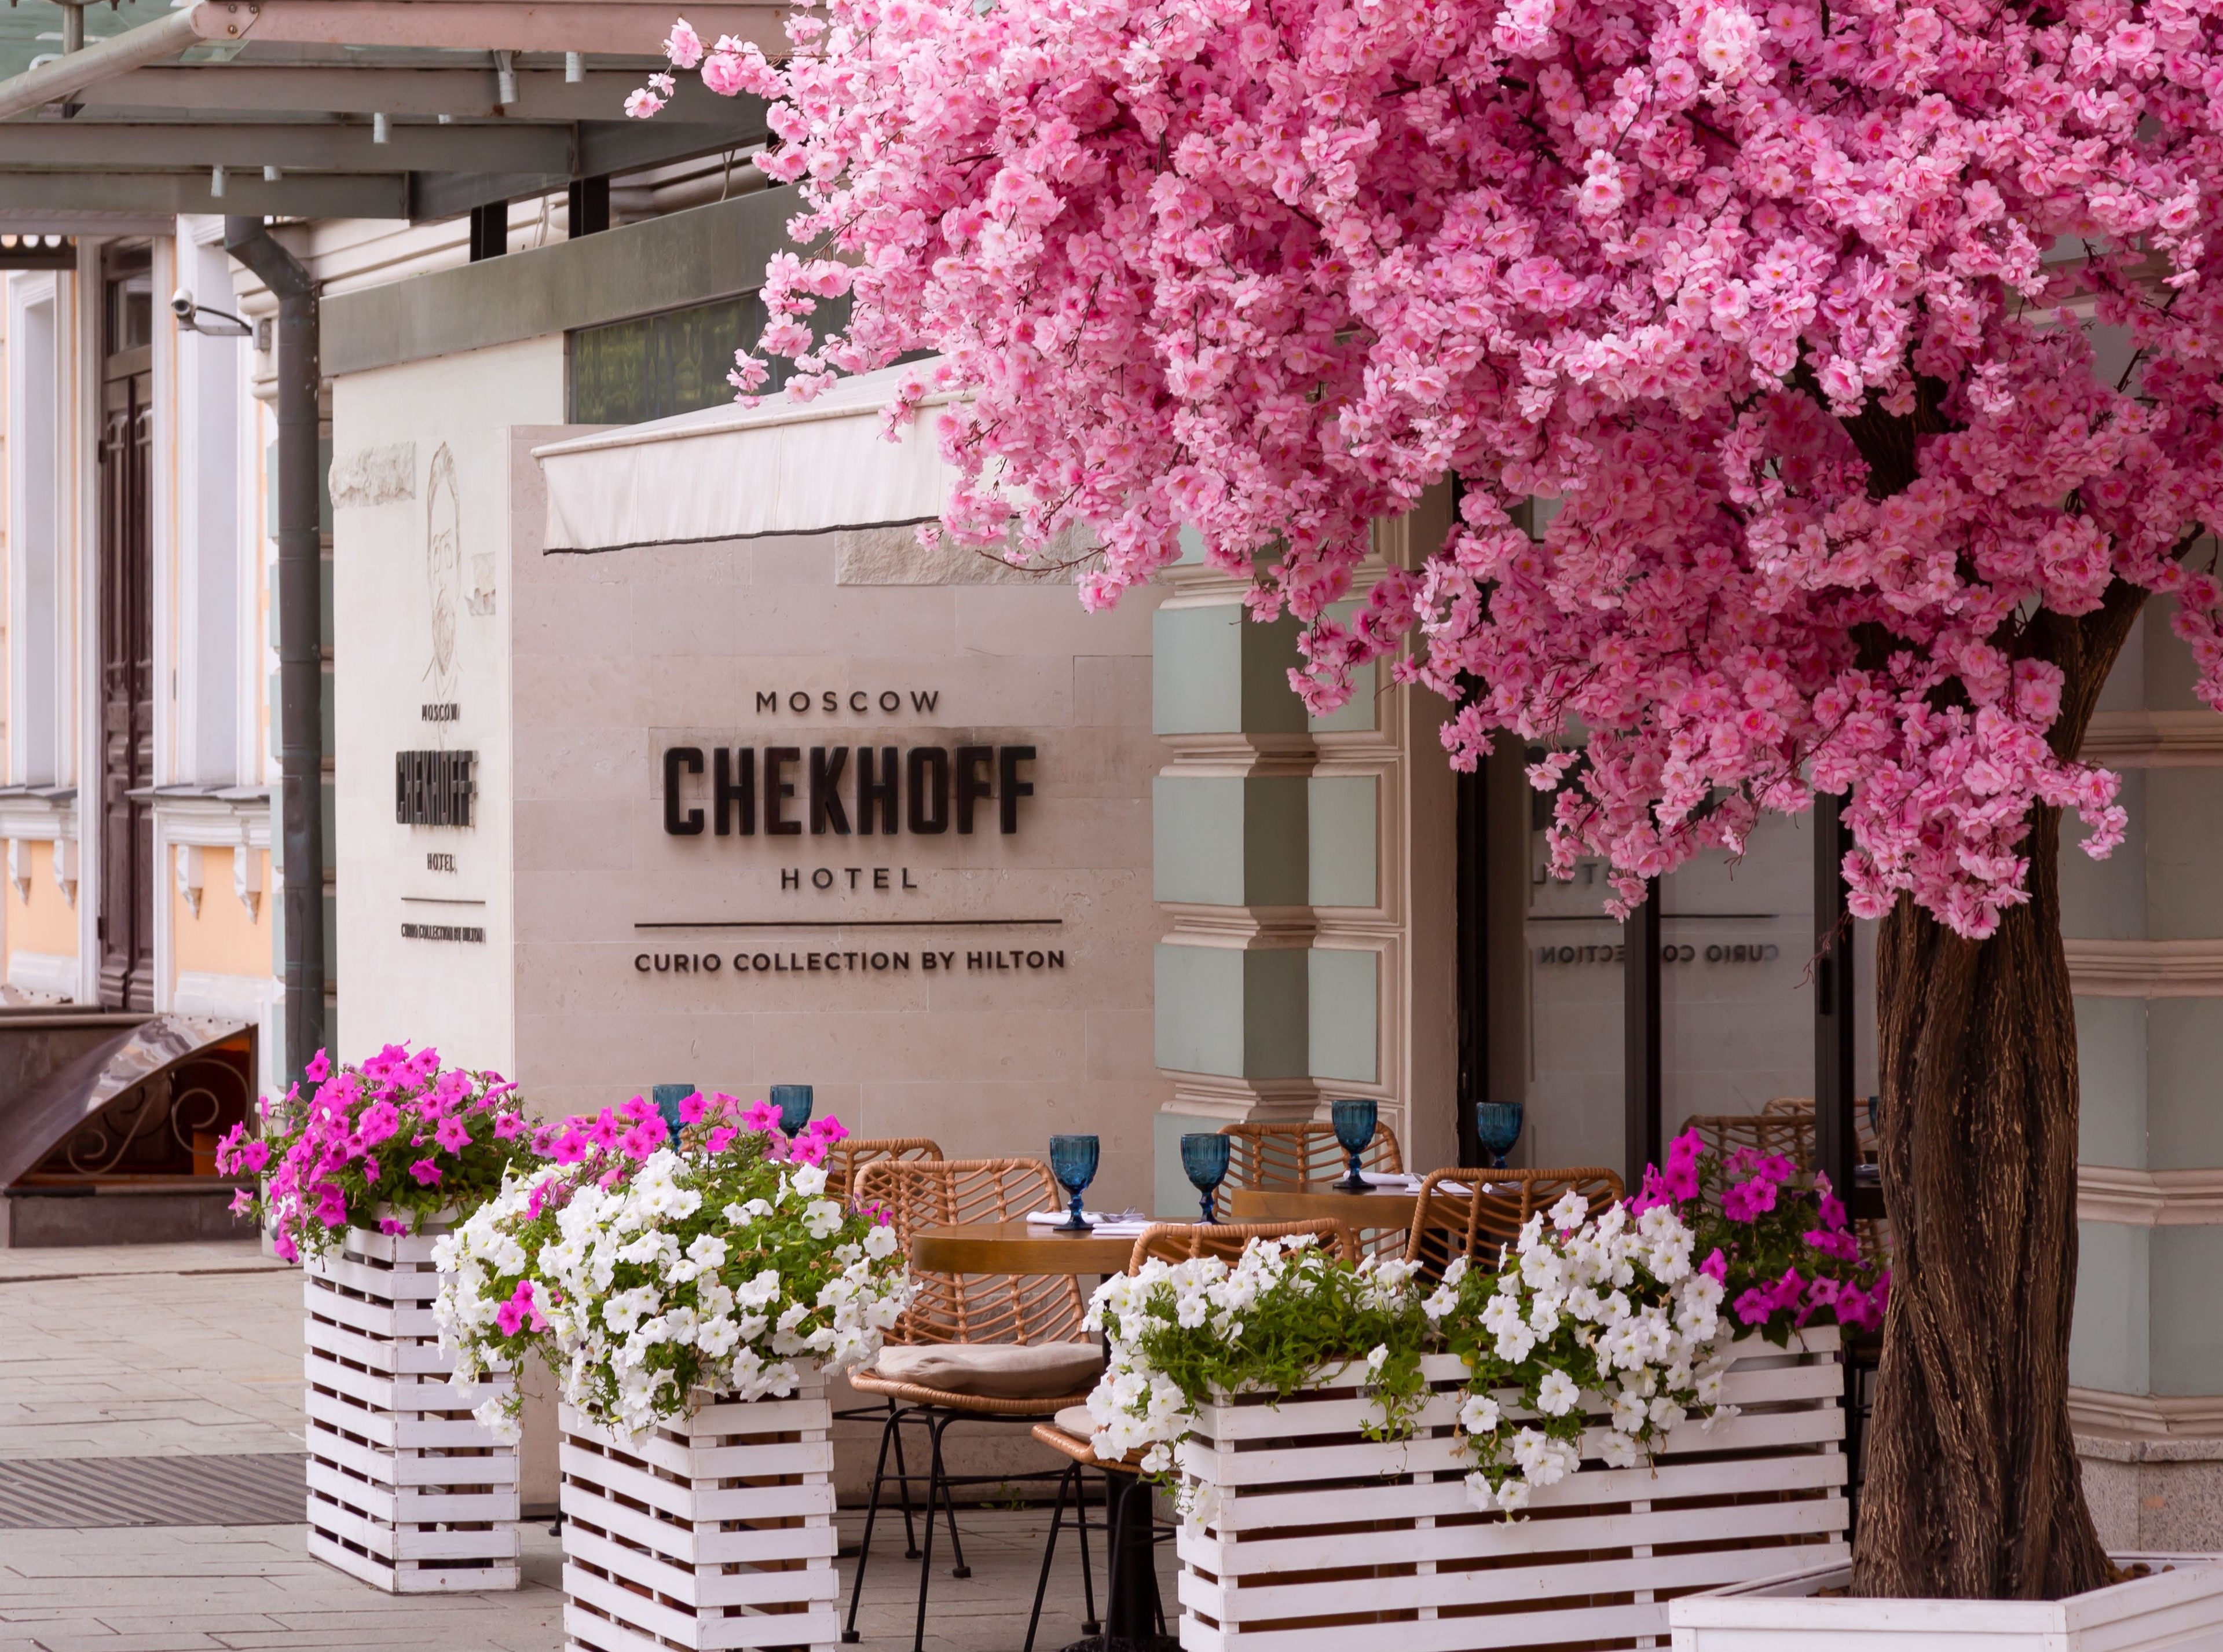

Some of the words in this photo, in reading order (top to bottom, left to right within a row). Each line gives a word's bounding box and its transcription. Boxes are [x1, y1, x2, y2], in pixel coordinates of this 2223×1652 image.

[422, 703, 460, 721] MOSCOW
[756, 691, 939, 713] MOSCOW
[664, 746, 1037, 836] CHEKHOFF
[427, 853, 456, 871] HOTEL
[781, 867, 918, 890] HOTEL
[635, 954, 722, 973] CURIO
[733, 951, 910, 972] COLLECTION
[922, 951, 954, 970] BY
[967, 950, 1065, 969] HILTON
